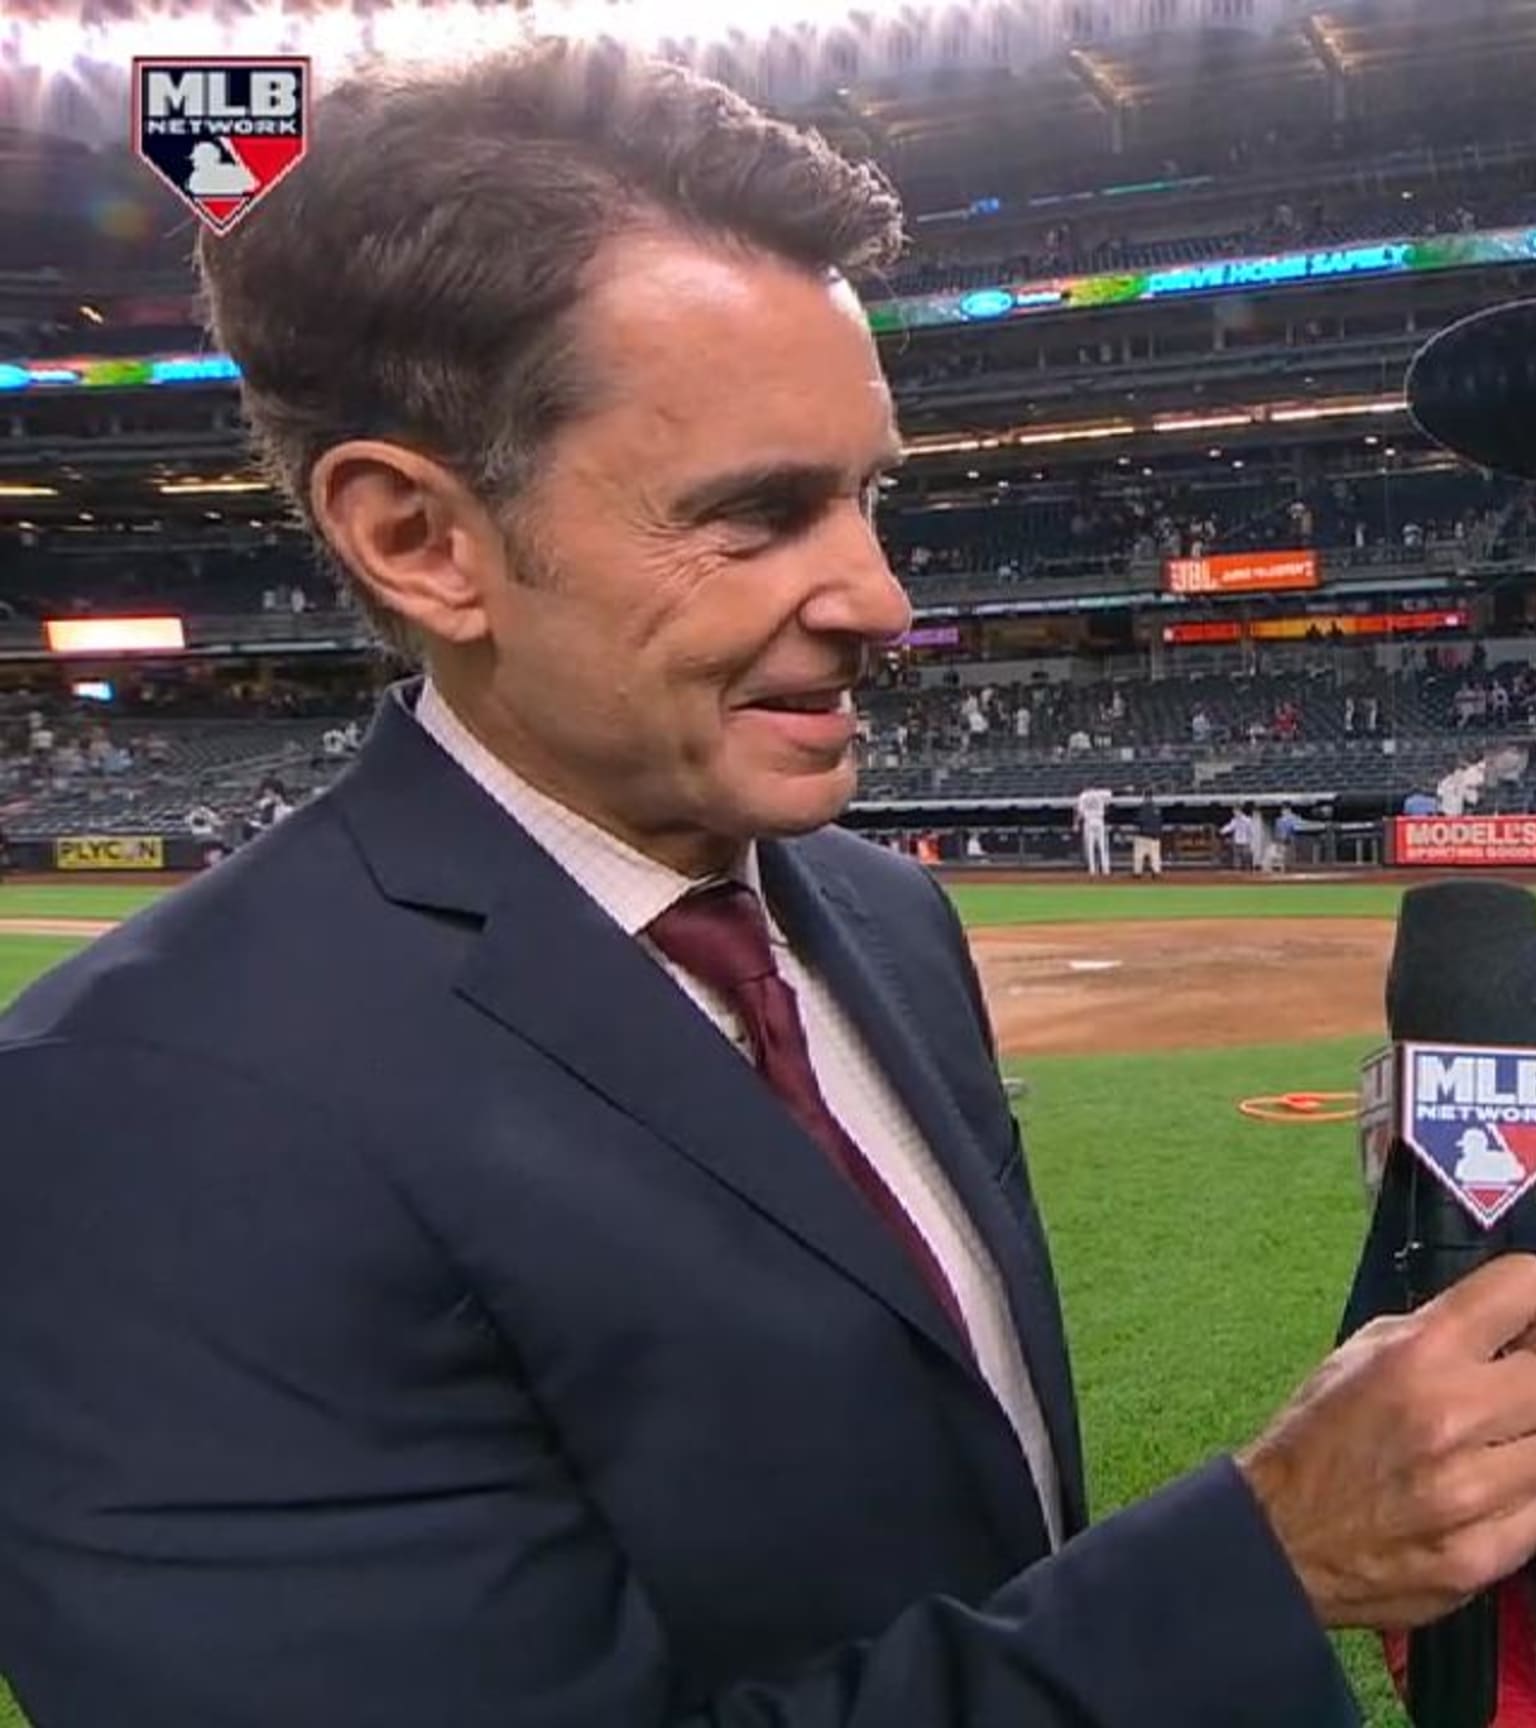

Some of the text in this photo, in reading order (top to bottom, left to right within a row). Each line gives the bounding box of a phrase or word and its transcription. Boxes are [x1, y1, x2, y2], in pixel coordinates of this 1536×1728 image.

[1229, 256, 1307, 286] HOME
[1310, 244, 1412, 275] SAFELY
[1169, 560, 1218, 592] JBL
